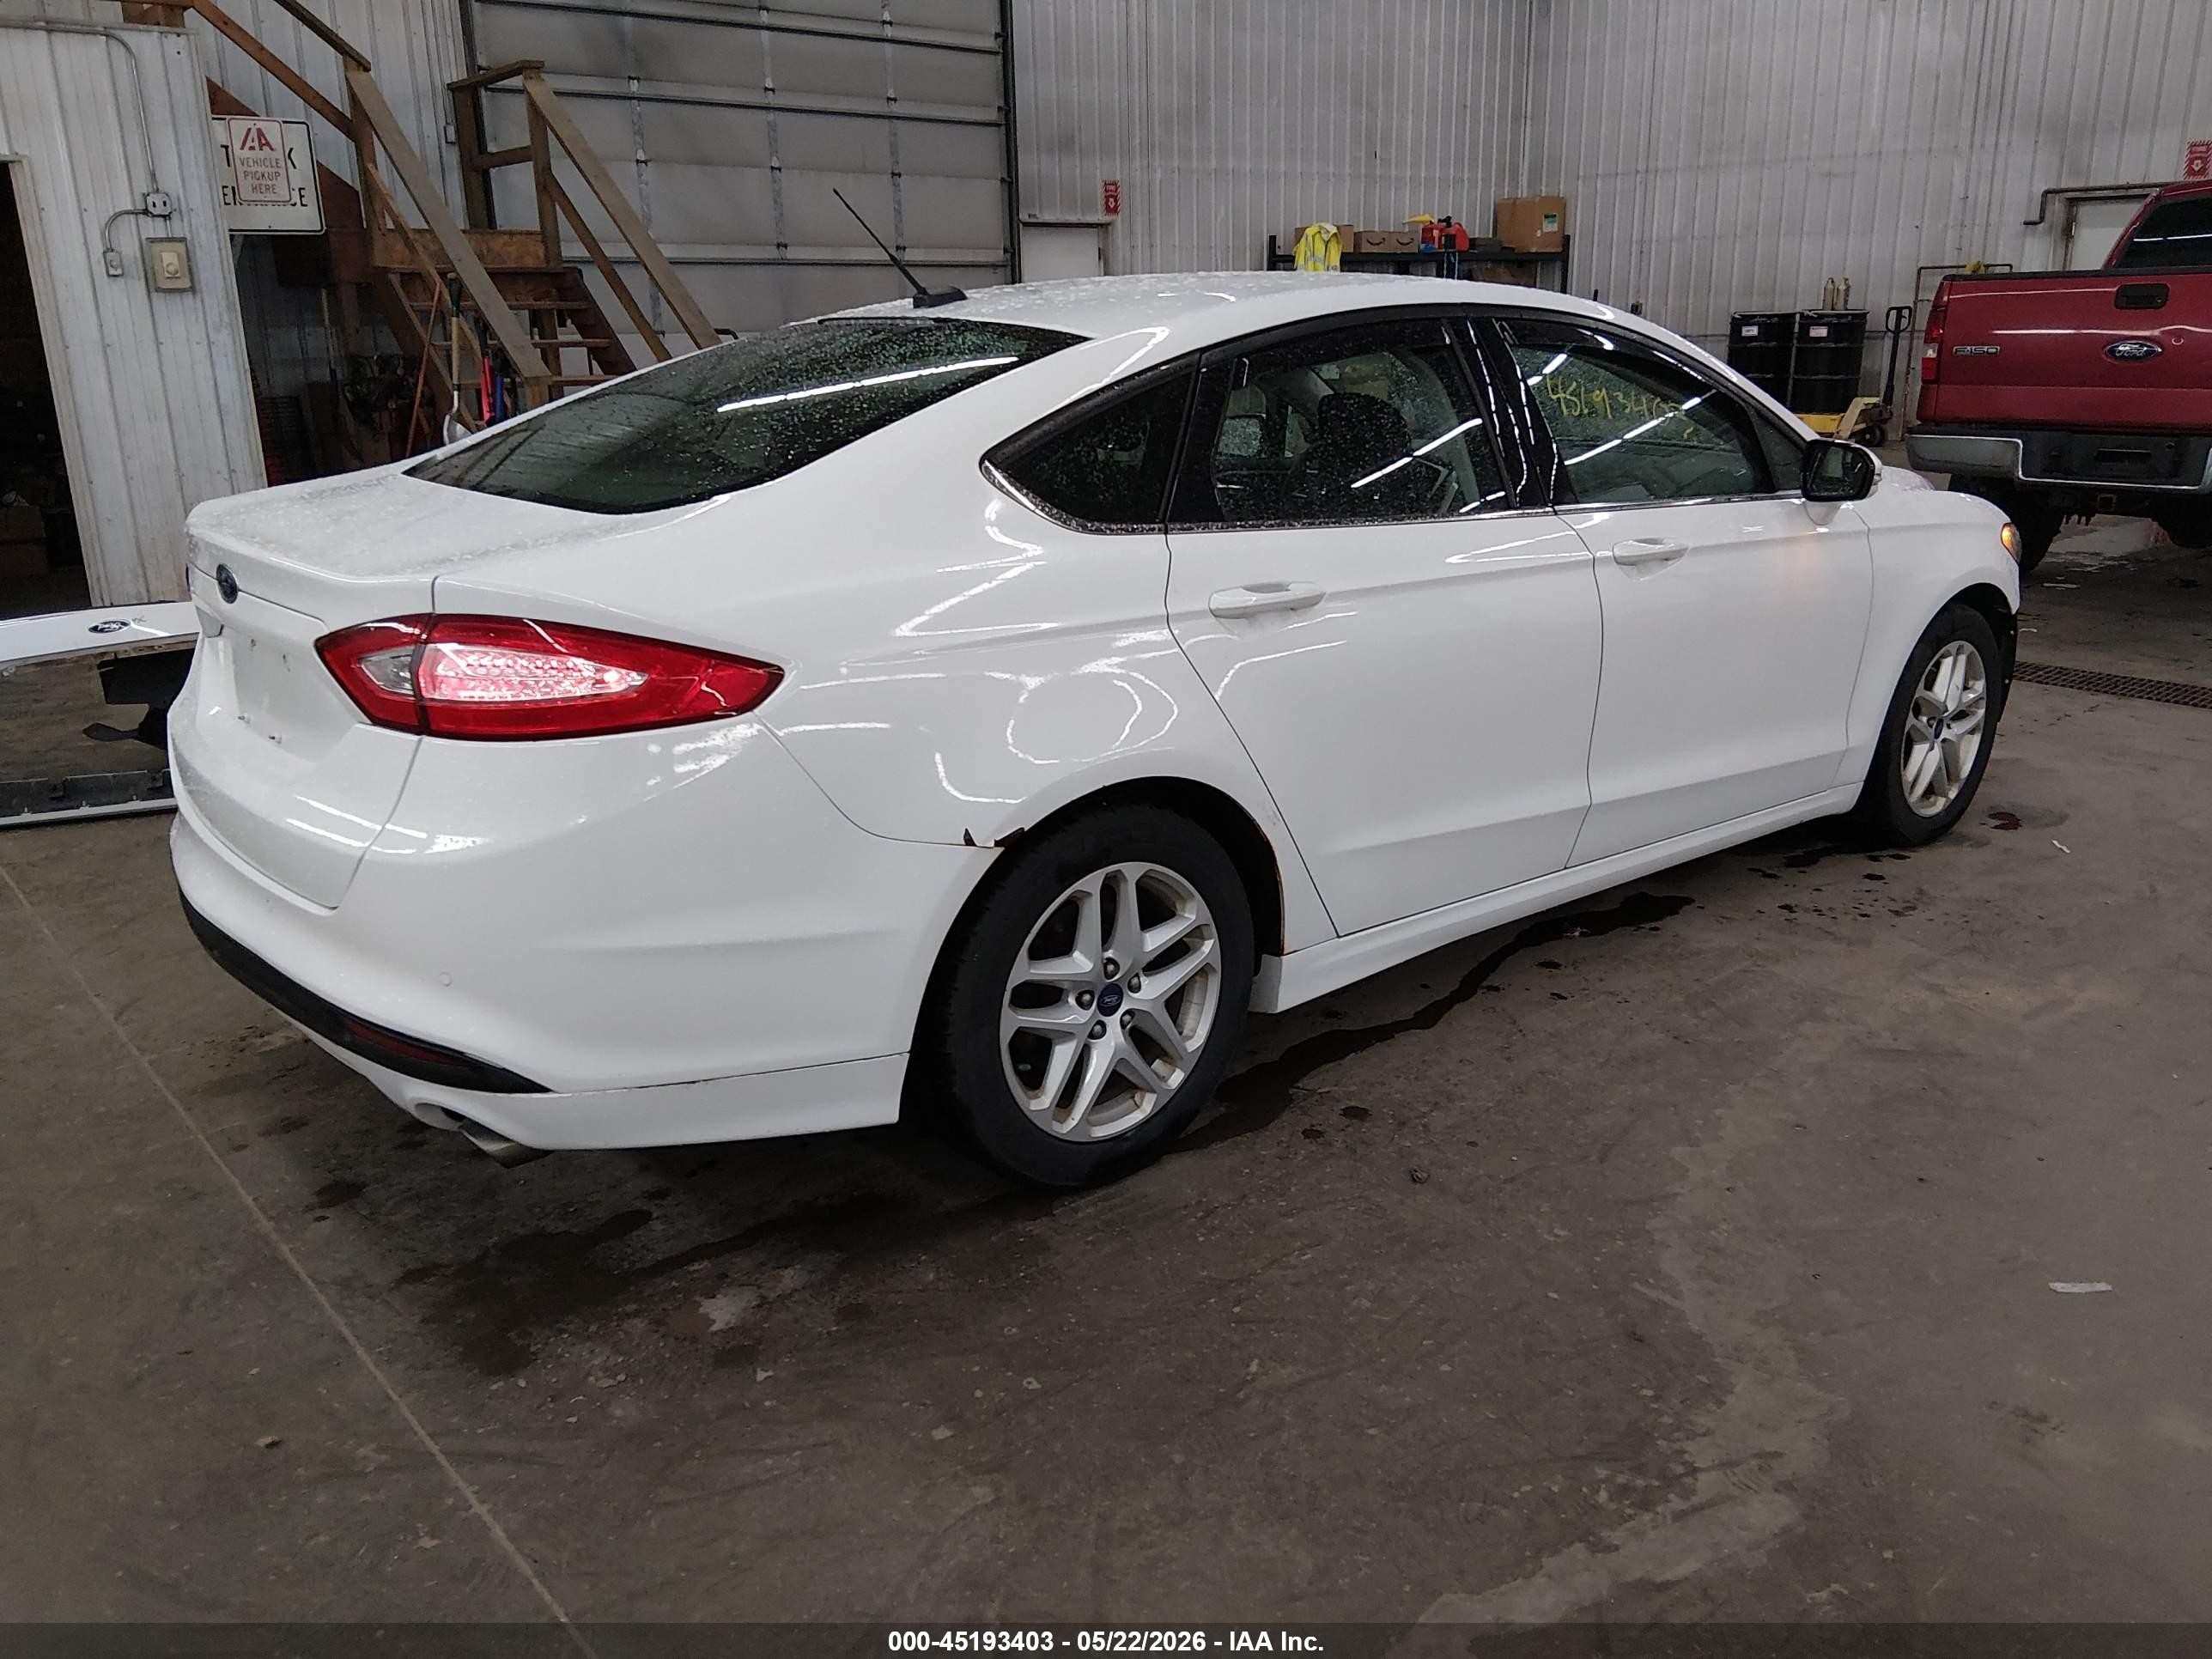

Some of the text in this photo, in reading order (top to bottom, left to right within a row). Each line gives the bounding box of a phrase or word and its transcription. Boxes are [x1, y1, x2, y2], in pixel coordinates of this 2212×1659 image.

[240, 157, 282, 168] VEHICLE
[243, 171, 281, 181] PICKUP
[251, 184, 277, 194] HERE
